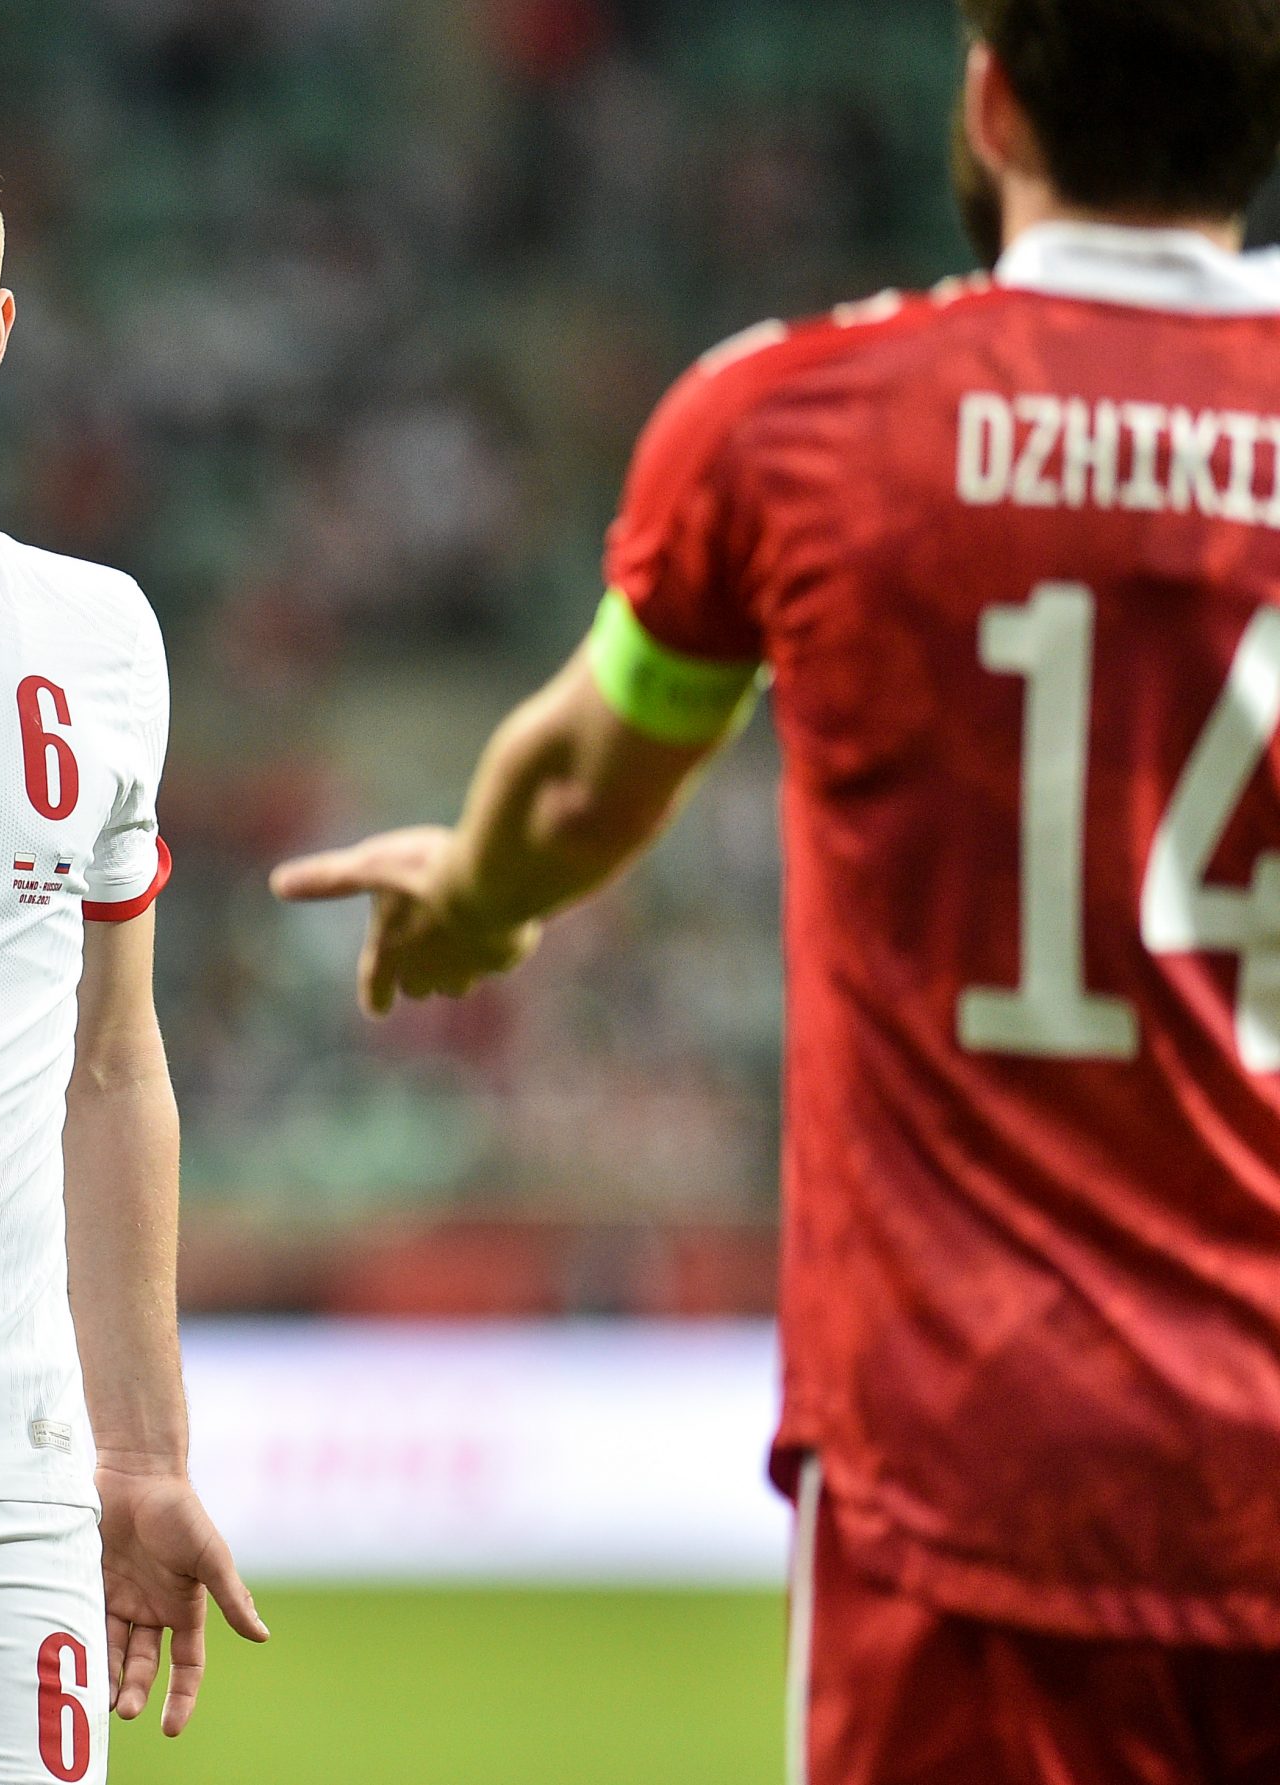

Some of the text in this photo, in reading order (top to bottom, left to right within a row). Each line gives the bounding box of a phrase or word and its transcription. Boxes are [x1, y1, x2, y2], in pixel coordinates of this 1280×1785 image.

[17, 675, 79, 821] 6
[13, 879, 39, 890] POLAND
[19, 894, 51, 905] 01.06.2021
[957, 581, 1280, 1074] 14
[37, 1632, 90, 1783] 6
